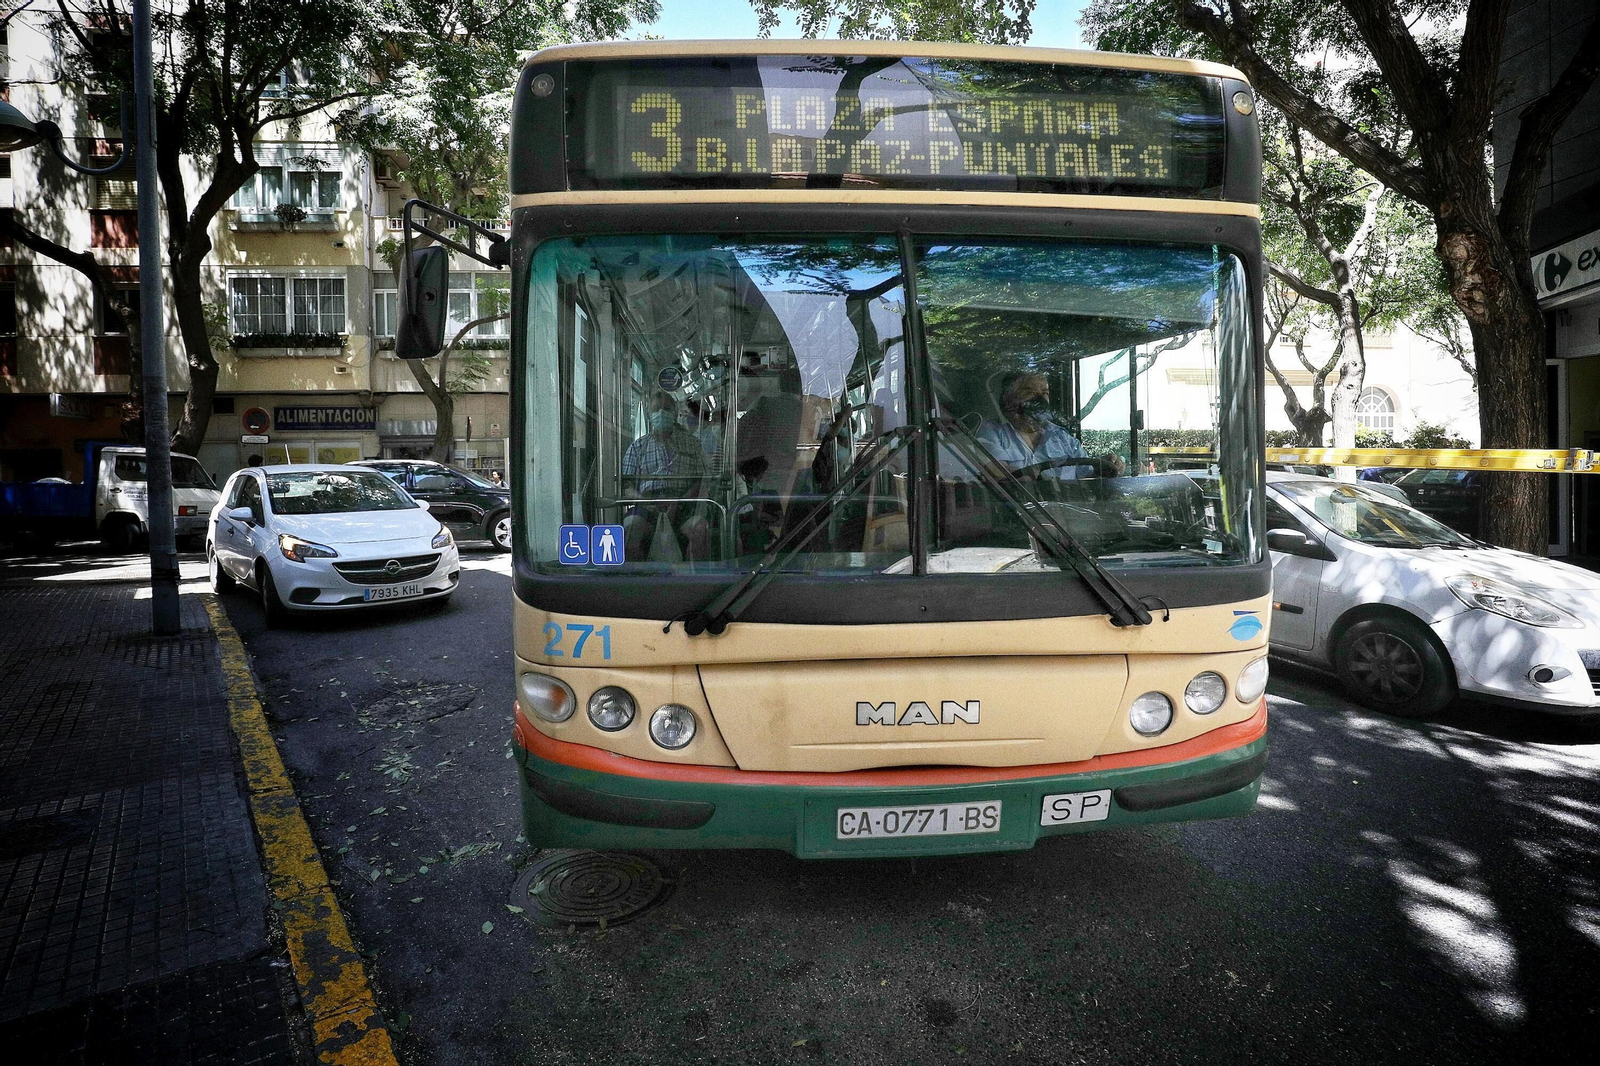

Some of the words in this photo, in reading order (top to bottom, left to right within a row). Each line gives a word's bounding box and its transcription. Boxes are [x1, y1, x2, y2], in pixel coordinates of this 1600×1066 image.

[735, 94, 895, 131] PLAZA
[631, 93, 682, 172] 3
[371, 587, 399, 600] 7935
[402, 584, 421, 596] KHL
[542, 621, 612, 660] 271
[855, 700, 980, 726] MAN
[1050, 794, 1102, 821] SP
